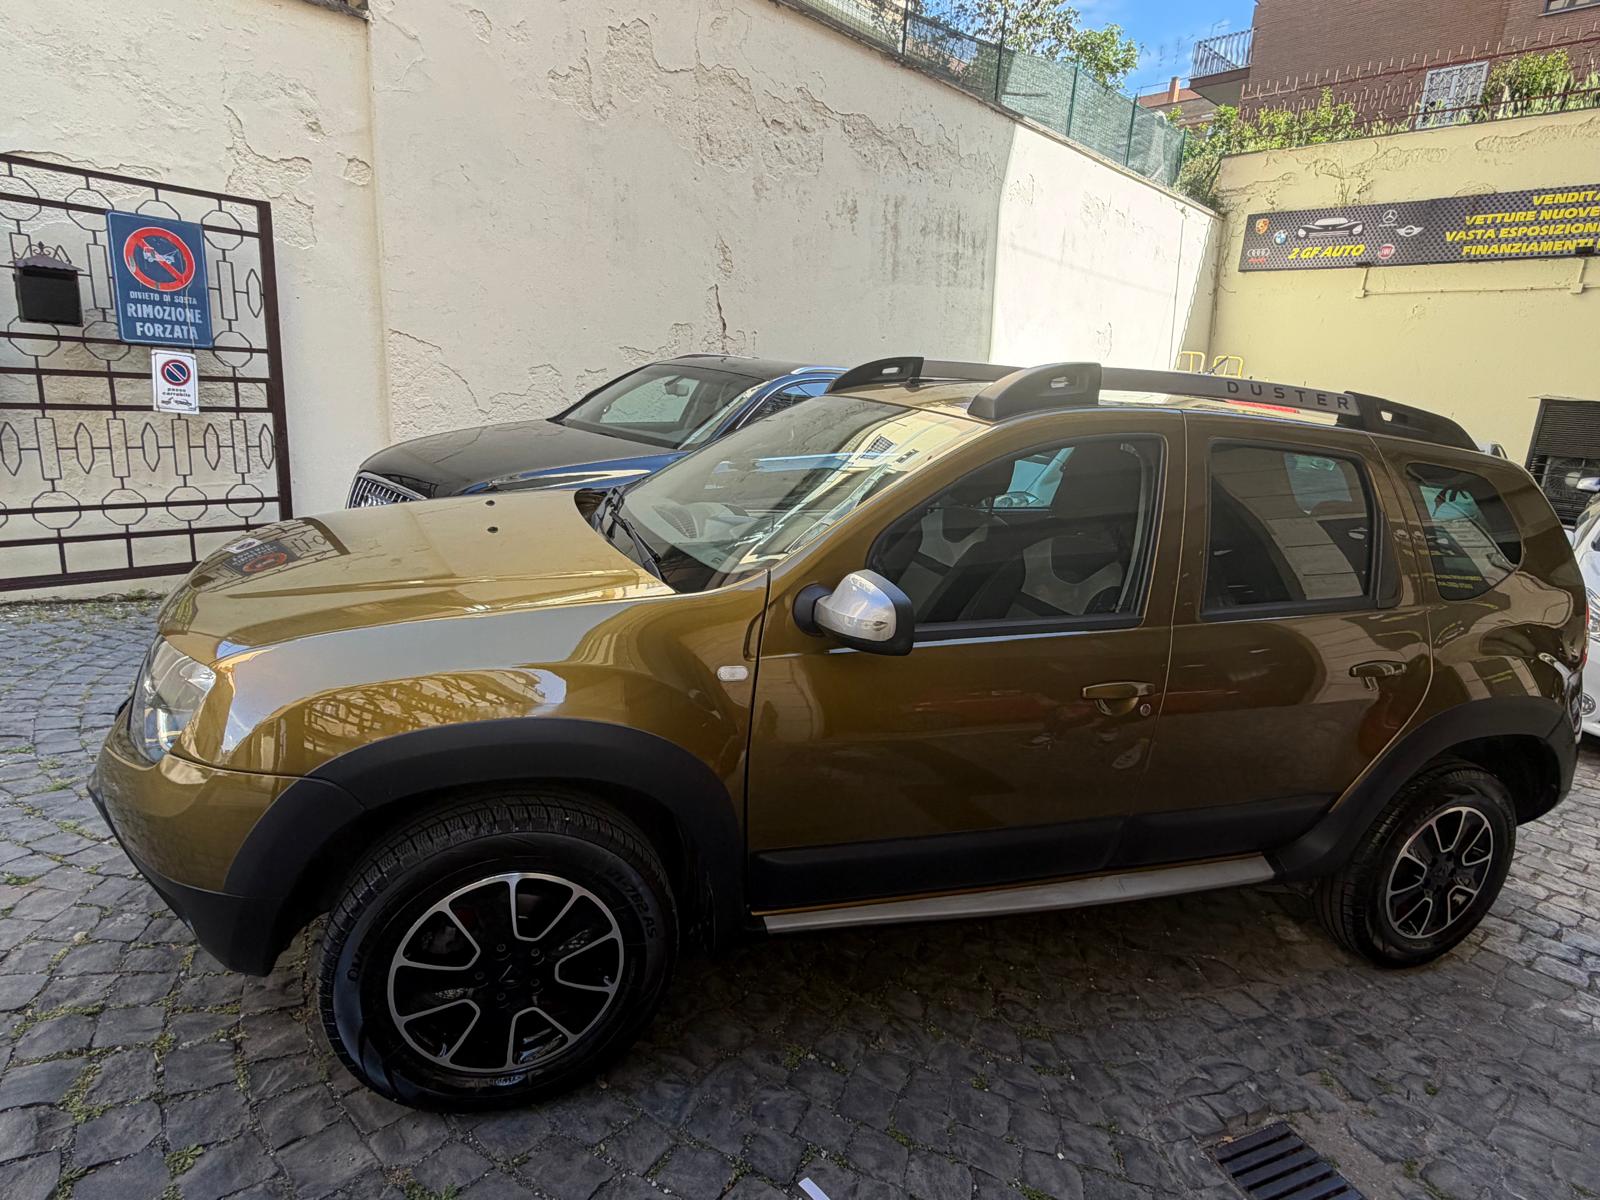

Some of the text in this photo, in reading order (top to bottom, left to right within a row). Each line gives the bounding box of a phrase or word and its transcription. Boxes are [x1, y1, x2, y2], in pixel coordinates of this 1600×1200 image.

[1465, 205, 1600, 225] VETTURE NUOVE
[1445, 222, 1600, 242] VASTA ESPOSIZION
[1287, 248, 1299, 259] 2
[1300, 246, 1322, 259] GF
[1320, 243, 1366, 258] AUTO
[1461, 238, 1594, 256] FINANZIAMENTI
[129, 290, 198, 305] DIVIETO DI SOSTA
[126, 302, 203, 324] RIMOZIONE
[135, 321, 200, 340] FORZATA
[1227, 381, 1350, 410] DUSTER
